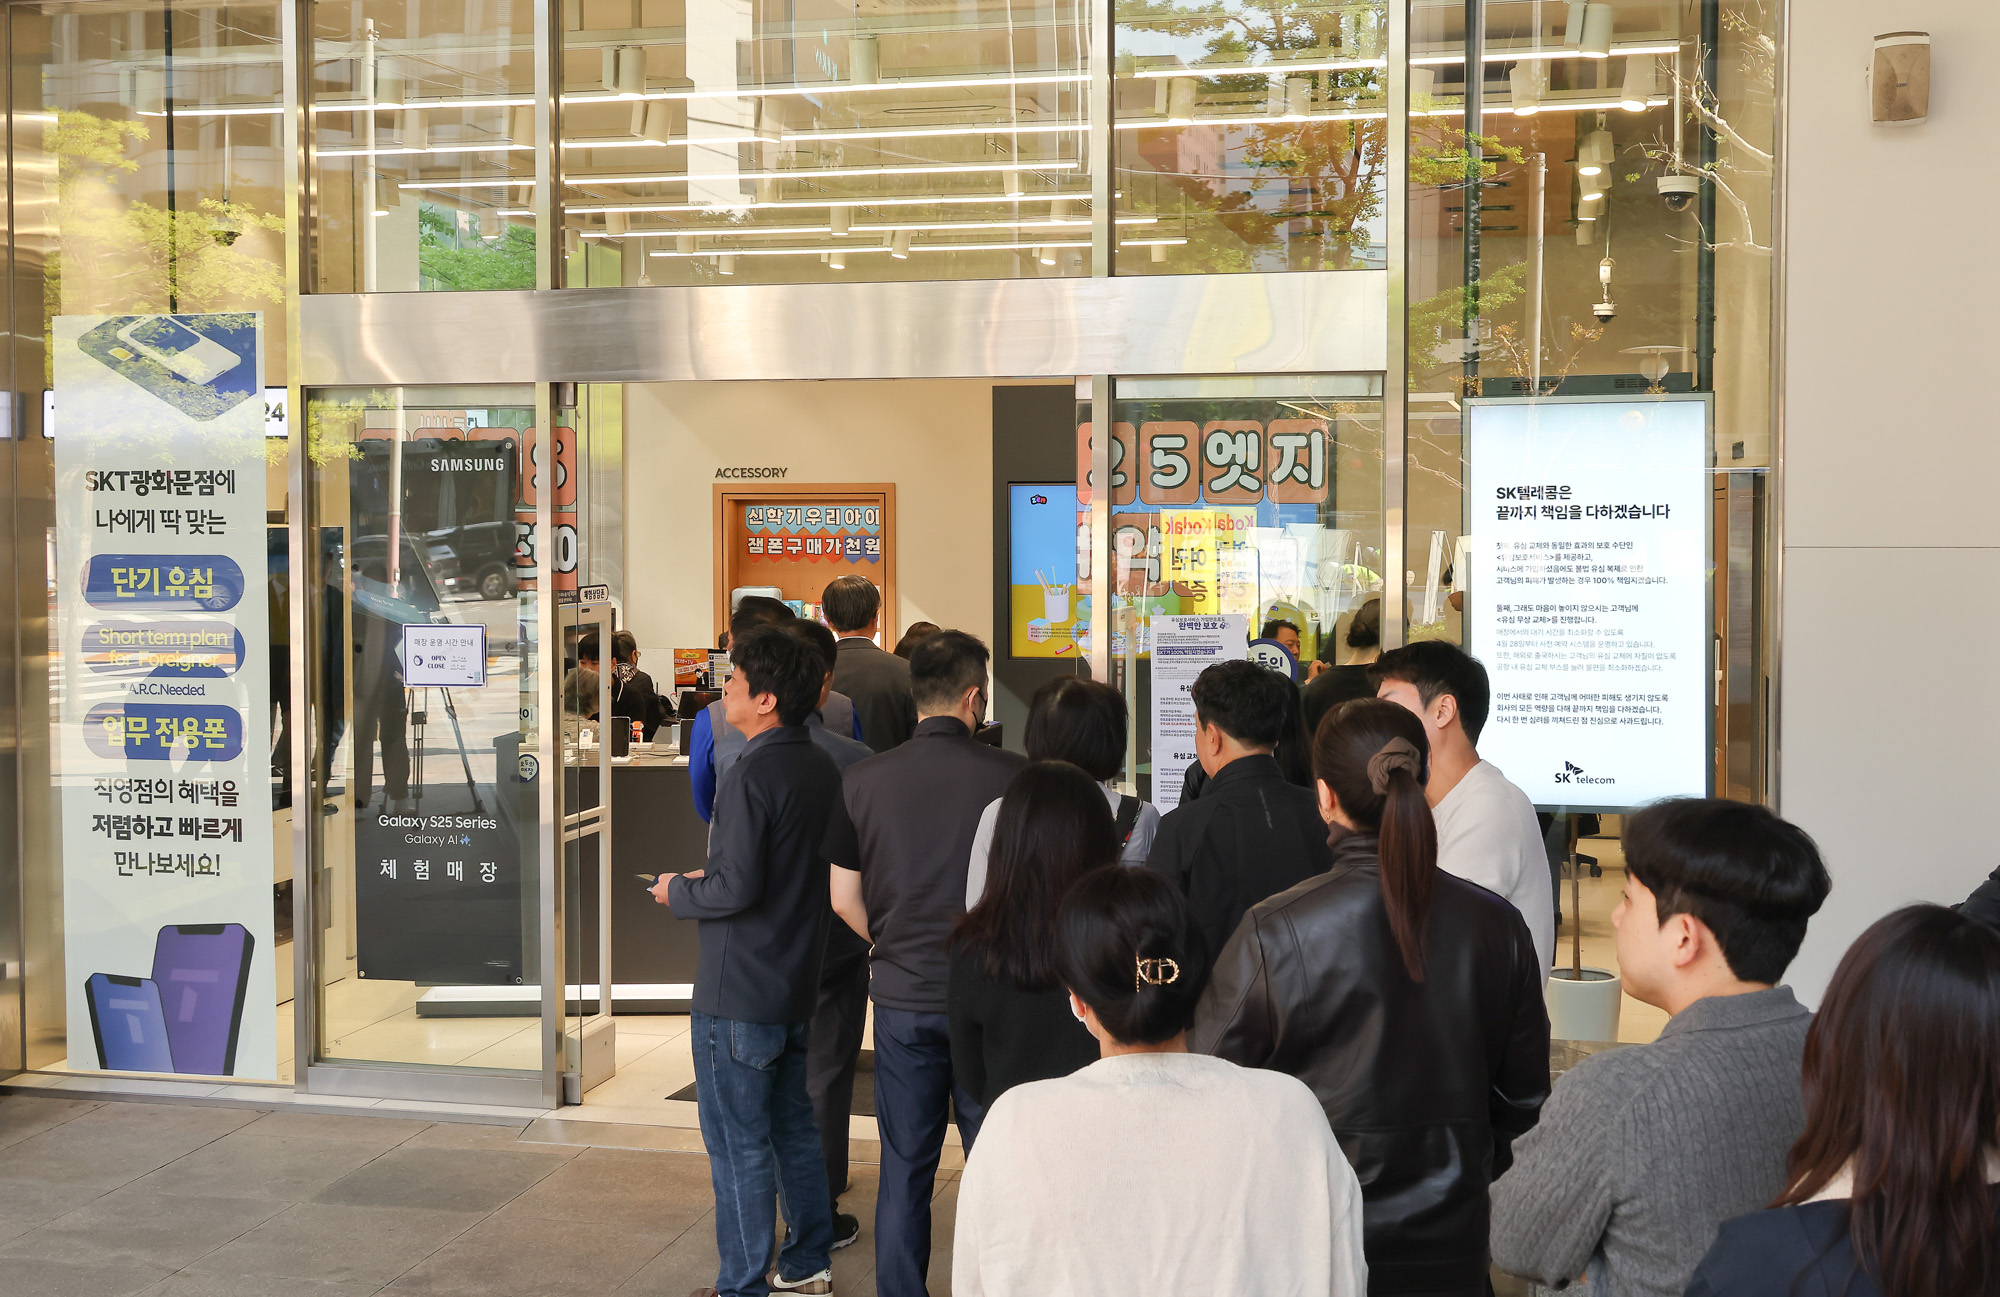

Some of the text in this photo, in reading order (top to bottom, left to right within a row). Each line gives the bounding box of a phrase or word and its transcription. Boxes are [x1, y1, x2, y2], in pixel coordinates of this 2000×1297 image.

[431, 458, 504, 472] SAMSUNG
[715, 467, 788, 478] ACCESSORY
[85, 470, 235, 496] SKT광화문점에
[1497, 485, 1572, 500] SK텔레콤은
[747, 507, 880, 525] 신학기우리아이
[1496, 504, 1670, 520] 끝까지 책임을 다하겠습니다
[96, 509, 227, 535] 나에게 딱 맞는
[747, 536, 880, 555] 잼폰구매가천원
[1513, 542, 1527, 550] 유심
[1551, 542, 1572, 550] 동일한
[1612, 541, 1633, 549] 수단인
[1563, 553, 1593, 562] 제공하고,
[1575, 565, 1589, 573] 불법
[1591, 565, 1605, 573] 유심
[111, 567, 213, 600] 단기 유심
[1496, 604, 1512, 613] 둘째,
[1514, 604, 1534, 612] 그래도
[1536, 604, 1556, 612] 마음이
[1178, 622, 1218, 630] 완벽한 보호
[1517, 616, 1531, 624] 무상
[1533, 616, 1558, 624] 교체>를
[1560, 616, 1596, 624] 진행합니다.
[99, 628, 228, 649] Short term plan
[414, 638, 474, 647] 매장 운영 시간 안내
[109, 650, 218, 671] for Foreigner
[1597, 652, 1610, 660] 유심
[1497, 663, 1510, 671] 공항
[1520, 663, 1532, 671] 유심
[1608, 664, 1663, 672] 최소화하겠습니다.
[1534, 693, 1548, 701] 인해
[1550, 693, 1577, 701] 고객님께
[1624, 694, 1645, 702] 생기지
[1647, 694, 1668, 702] 않도록
[1497, 704, 1517, 712] 회사의
[1572, 705, 1593, 713] 끝까지
[1595, 705, 1616, 713] 책임을
[1521, 716, 1527, 724] 번
[1529, 716, 1550, 724] 심려를
[1590, 717, 1617, 725] 진심으로
[1619, 717, 1663, 725] 사과드립니다.
[102, 717, 228, 749] 업무 전용폰
[1555, 773, 1615, 784] SK telecom
[94, 778, 239, 807] 직영점의 혜택을
[92, 814, 243, 842] 저렴하고 빠르게
[378, 815, 497, 831] Galaxy S25 Series
[404, 833, 458, 847] Galaxy AI
[114, 851, 220, 877] 만나보세요!
